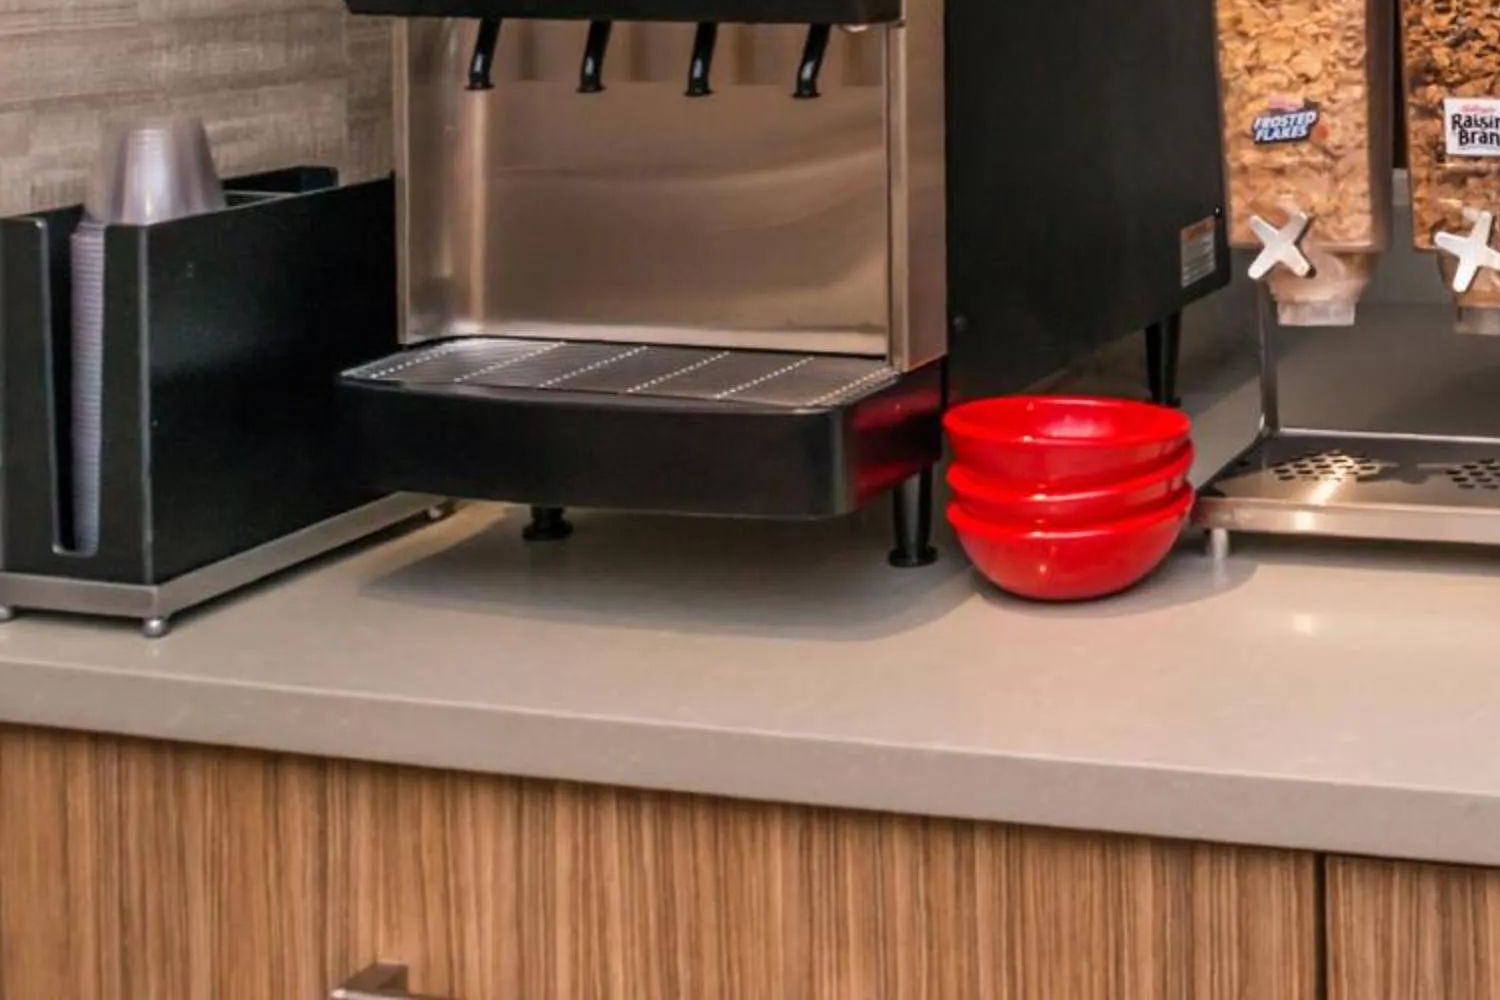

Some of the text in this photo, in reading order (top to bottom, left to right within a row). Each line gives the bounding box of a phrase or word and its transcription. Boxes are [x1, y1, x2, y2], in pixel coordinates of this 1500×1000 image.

[1254, 111, 1317, 131] FROSTED
[1254, 123, 1308, 142] FLAKES
[1458, 128, 1500, 147] Bran
